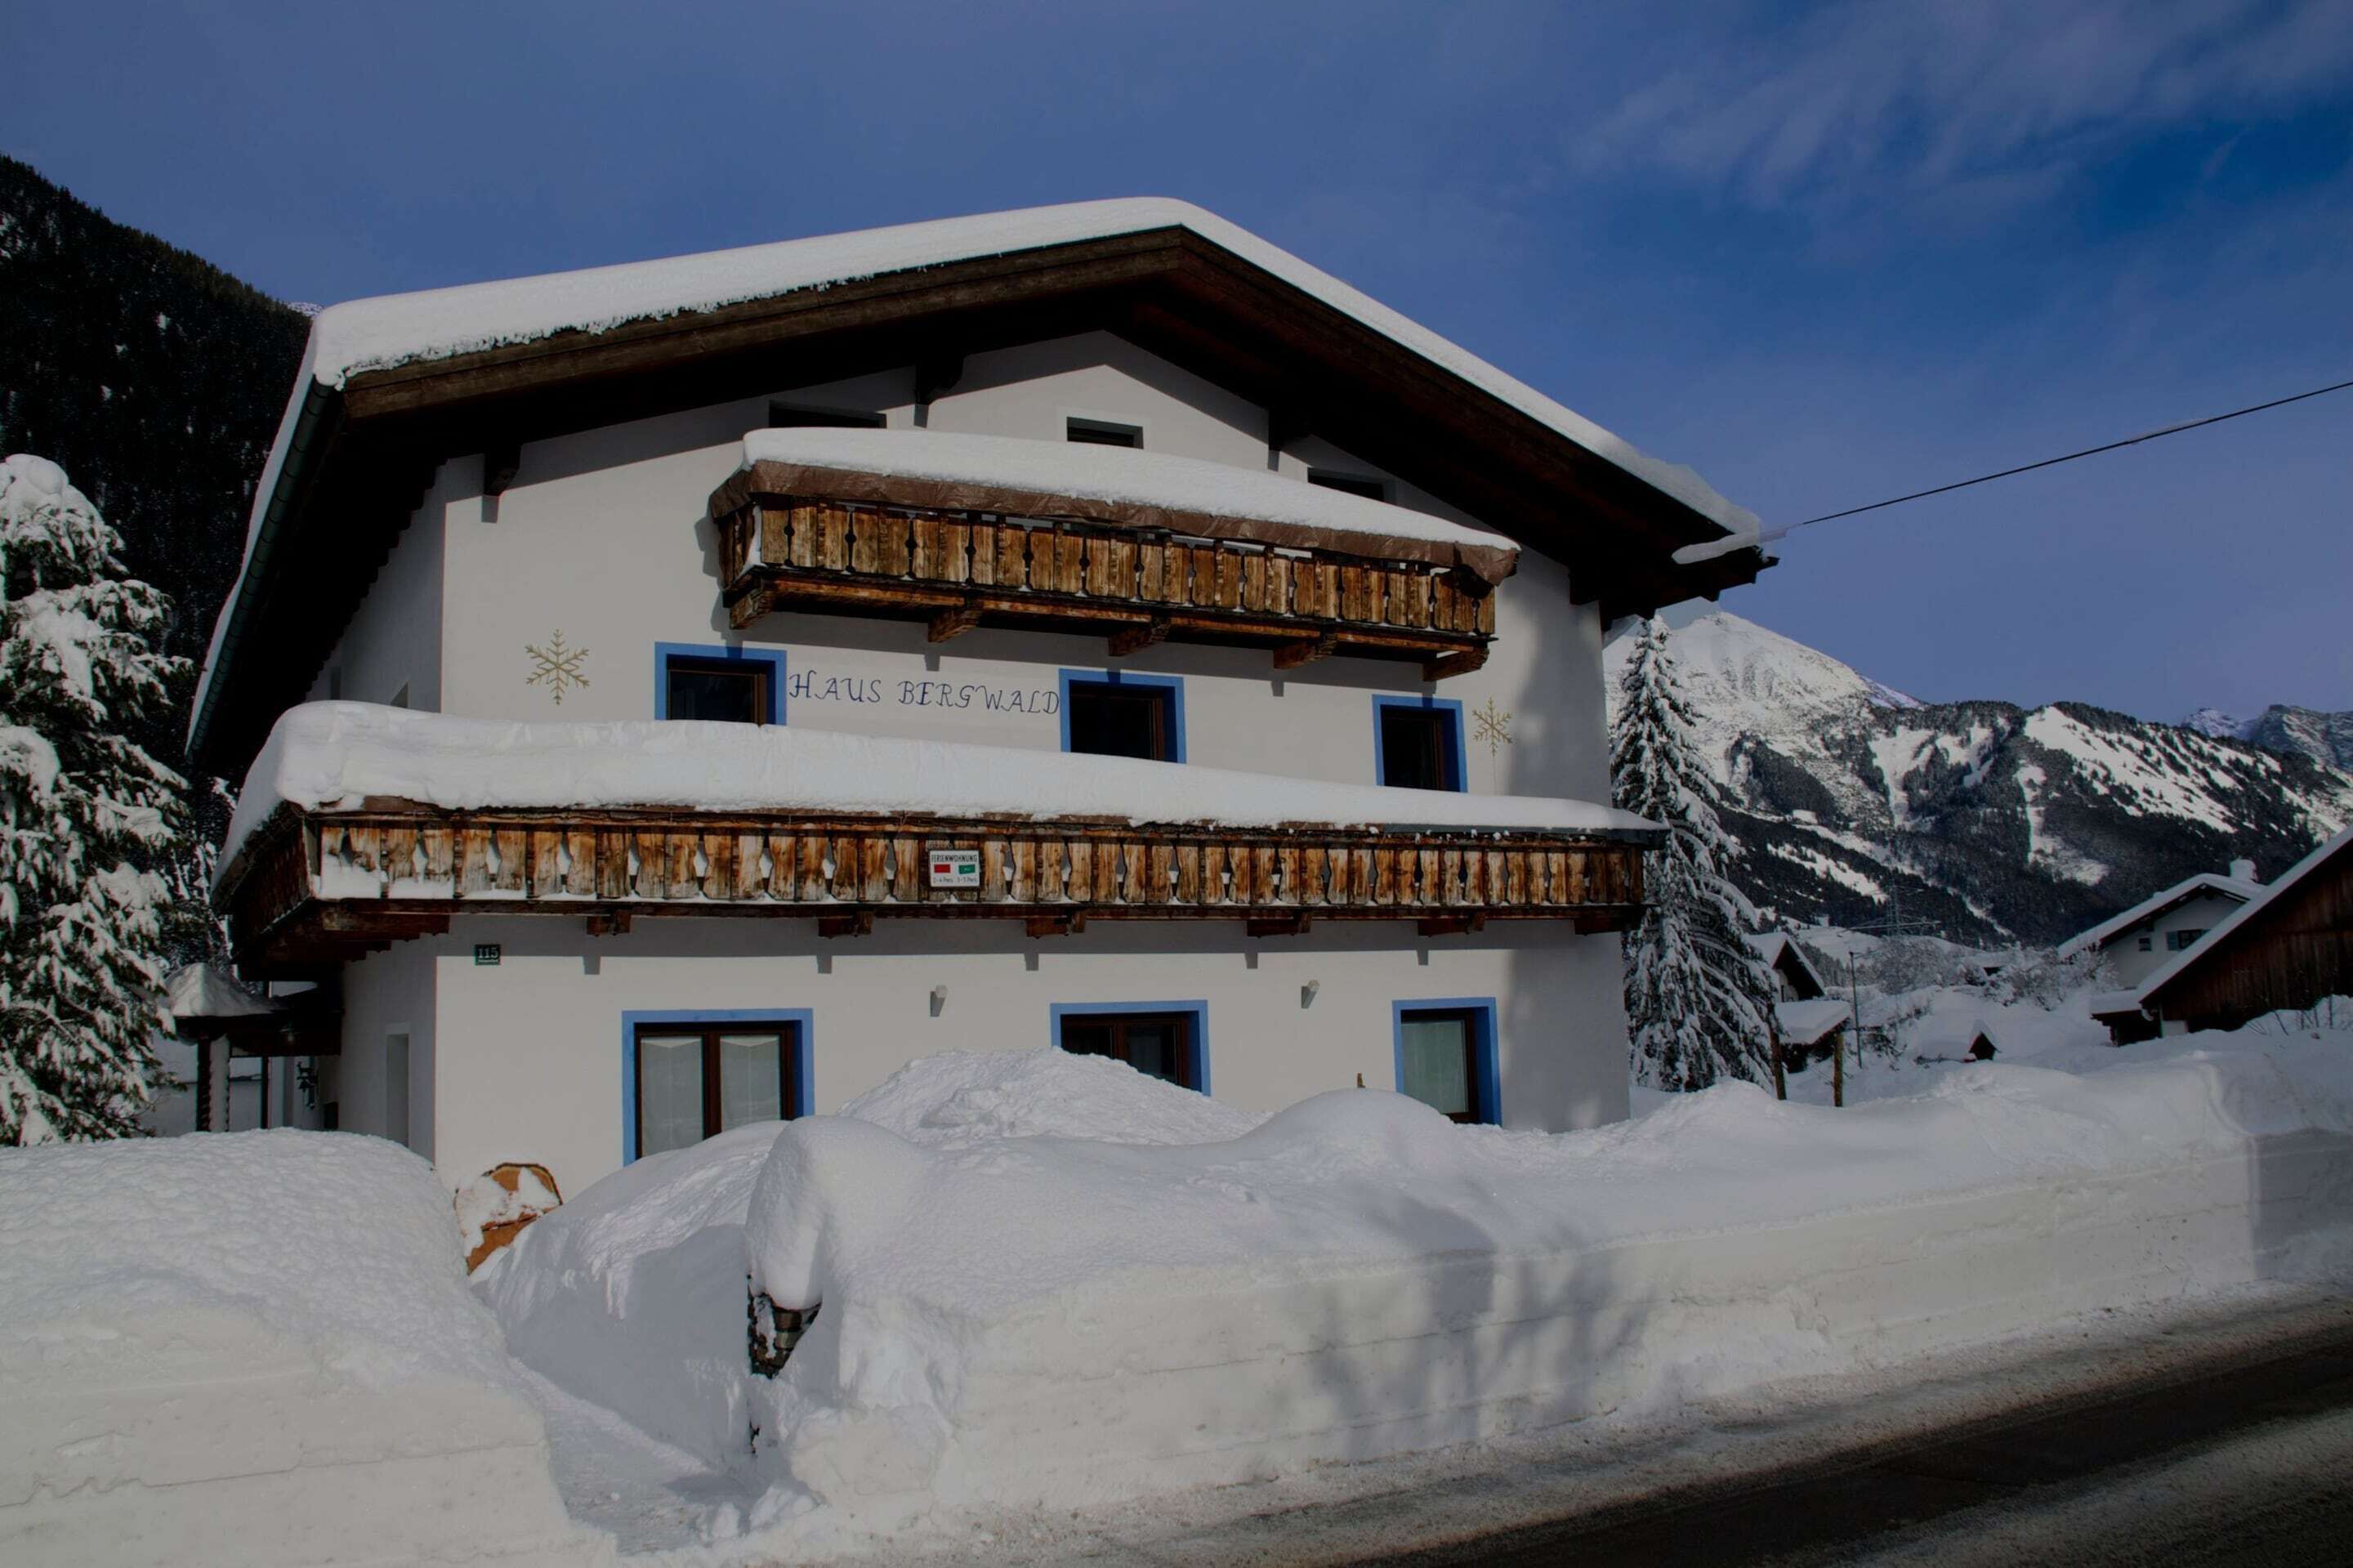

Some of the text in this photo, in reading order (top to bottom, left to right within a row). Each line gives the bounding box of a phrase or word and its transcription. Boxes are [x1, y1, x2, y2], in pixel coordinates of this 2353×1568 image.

[788, 670, 1060, 714] HAUS BERGWALD
[478, 948, 498, 958] 115
